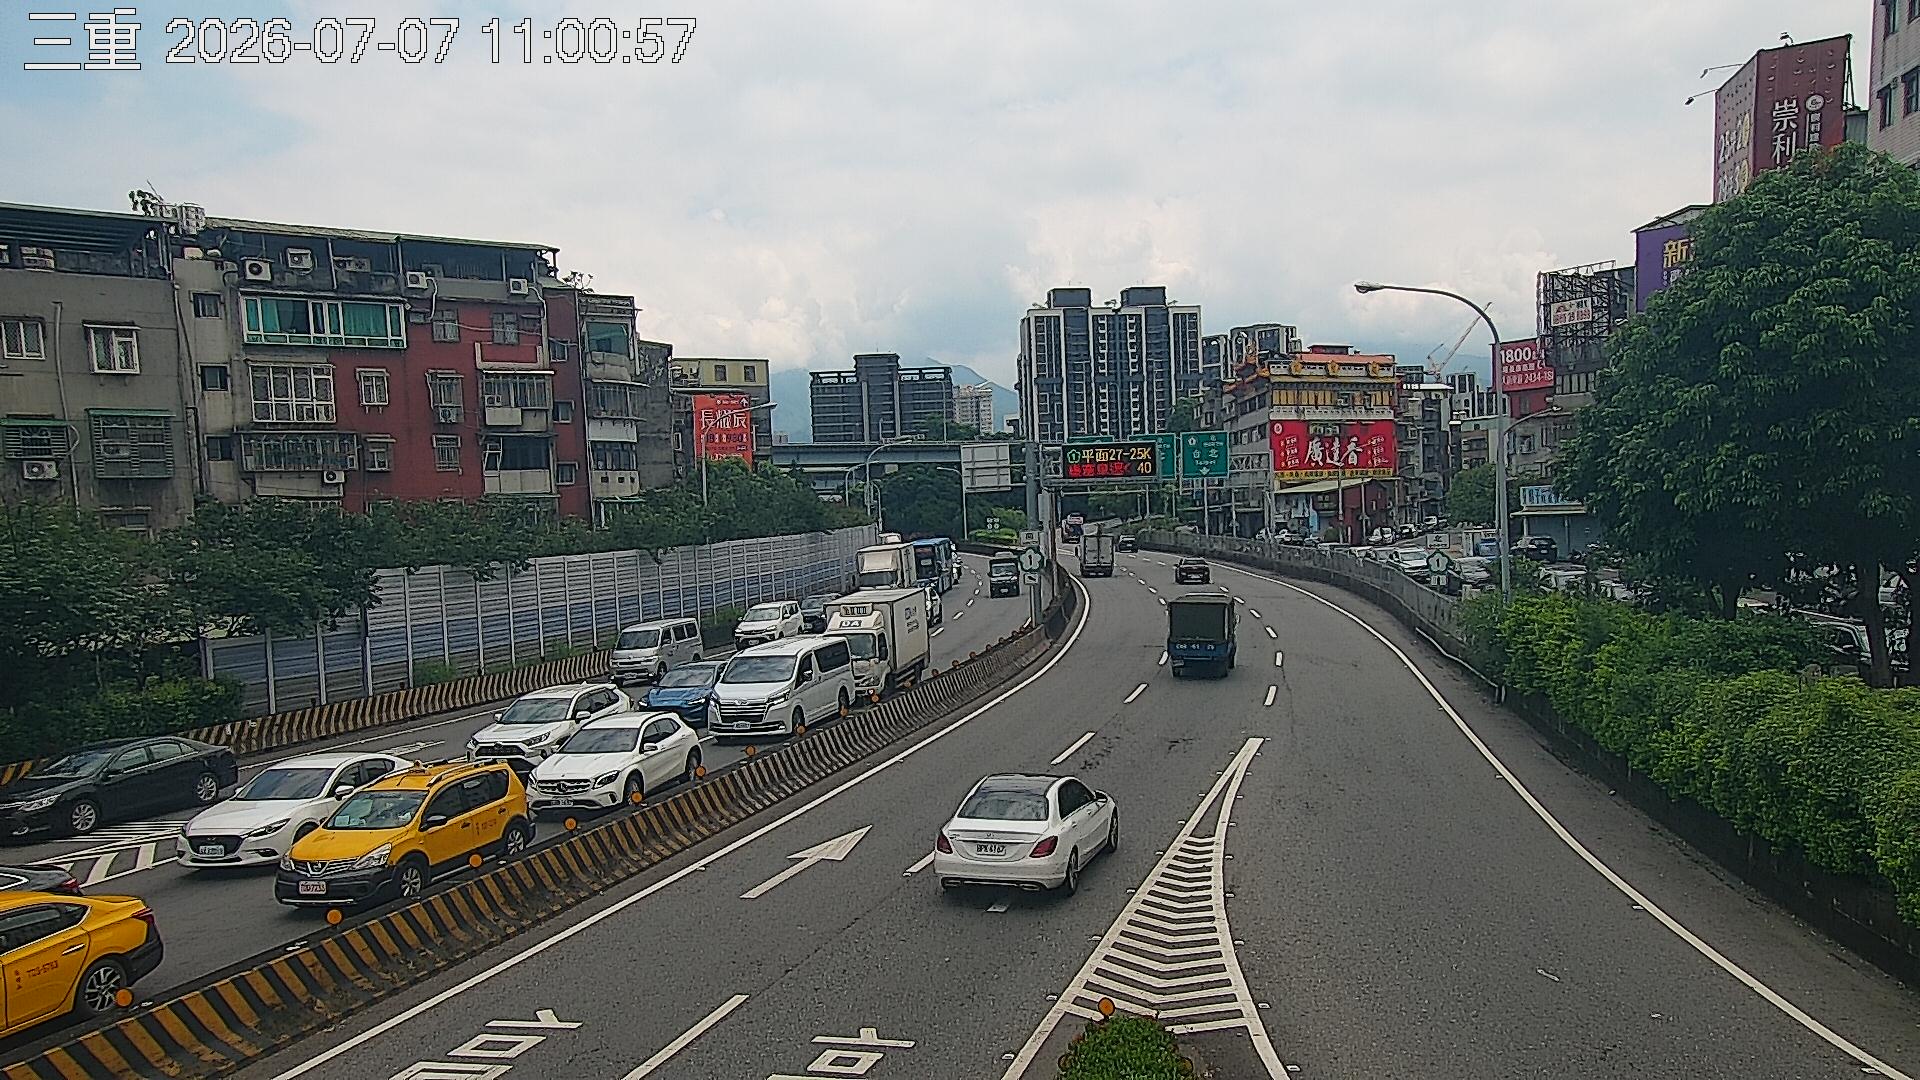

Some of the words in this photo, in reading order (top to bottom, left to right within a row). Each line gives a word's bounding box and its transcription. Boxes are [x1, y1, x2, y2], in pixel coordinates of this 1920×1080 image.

[1772, 99, 1799, 169] 崇利
[1663, 239, 1694, 268] 新
[1136, 461, 1152, 474] 40
